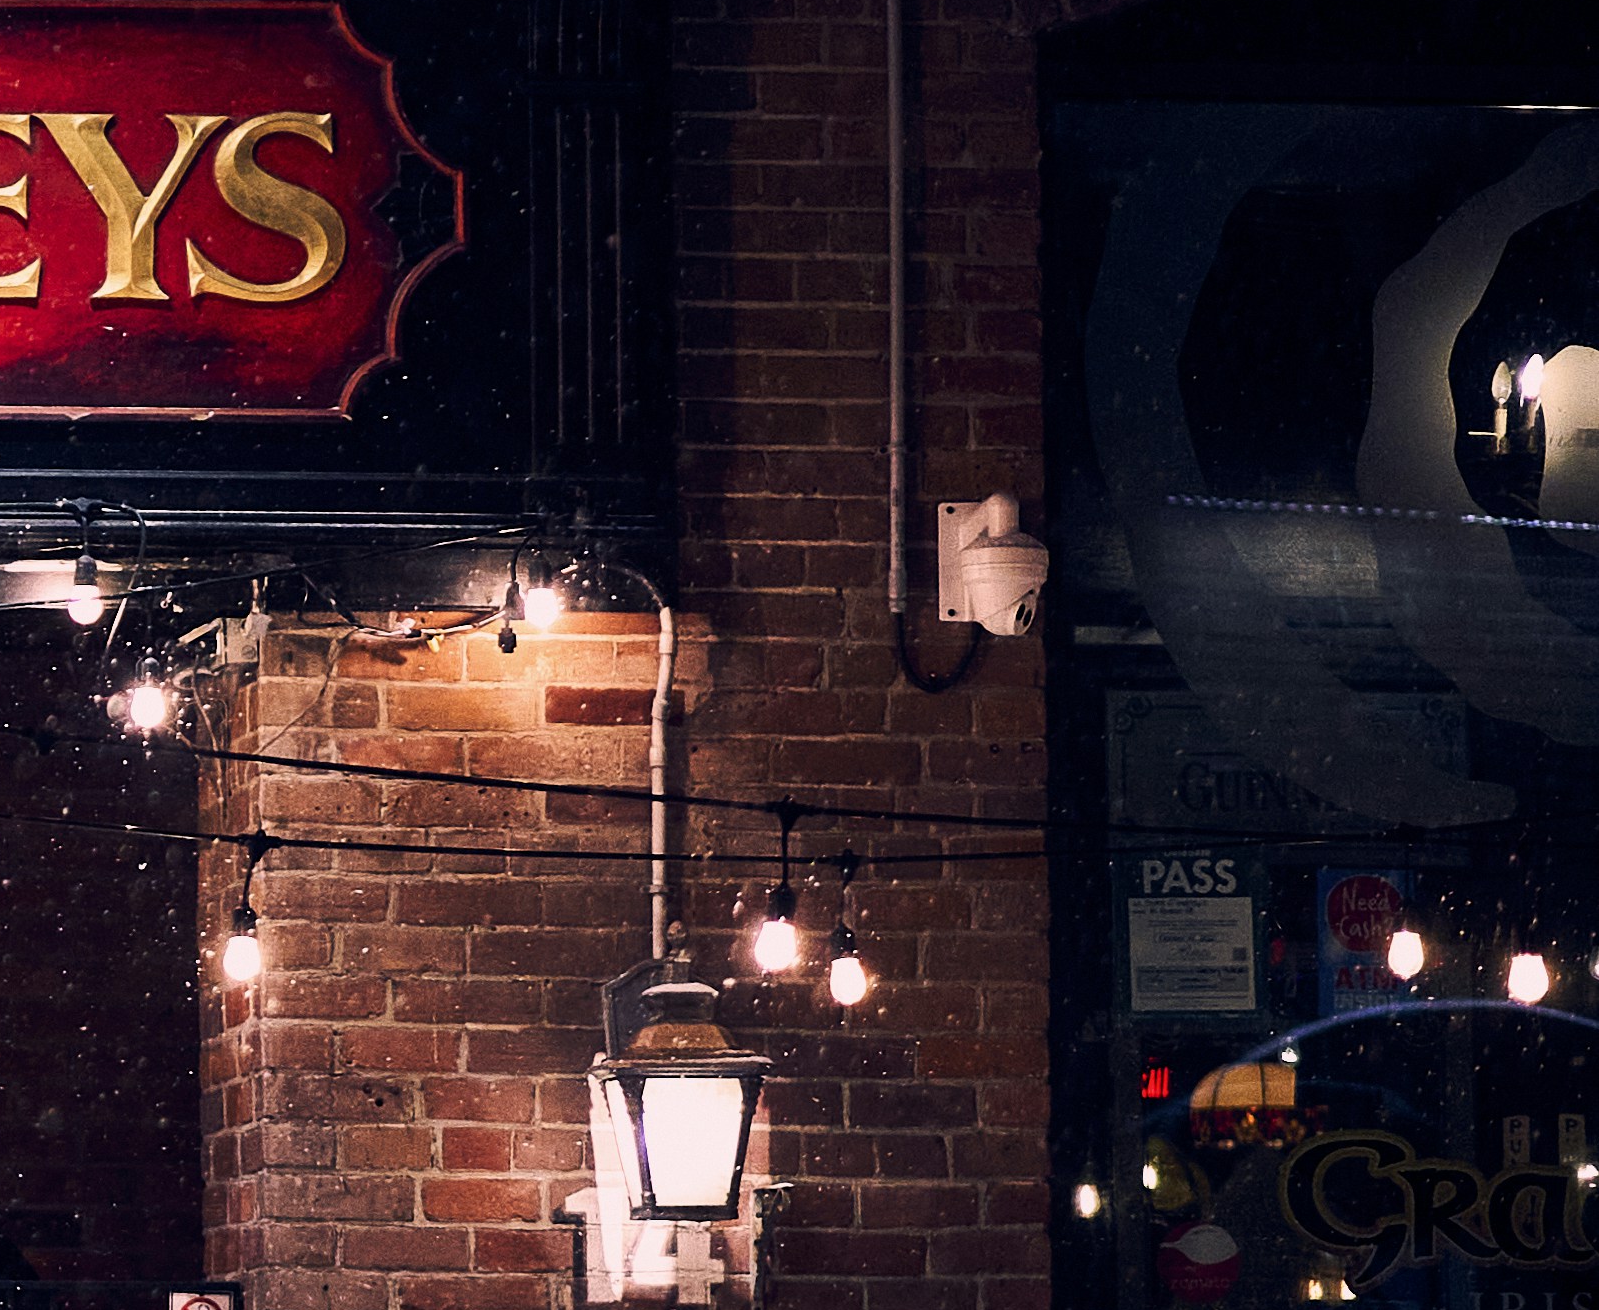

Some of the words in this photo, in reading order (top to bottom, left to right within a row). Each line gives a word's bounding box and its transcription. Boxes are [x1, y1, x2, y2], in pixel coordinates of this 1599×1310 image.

[1142, 858, 1238, 895] PASS
[1342, 879, 1391, 915] Need
[1335, 966, 1399, 990] ATM
